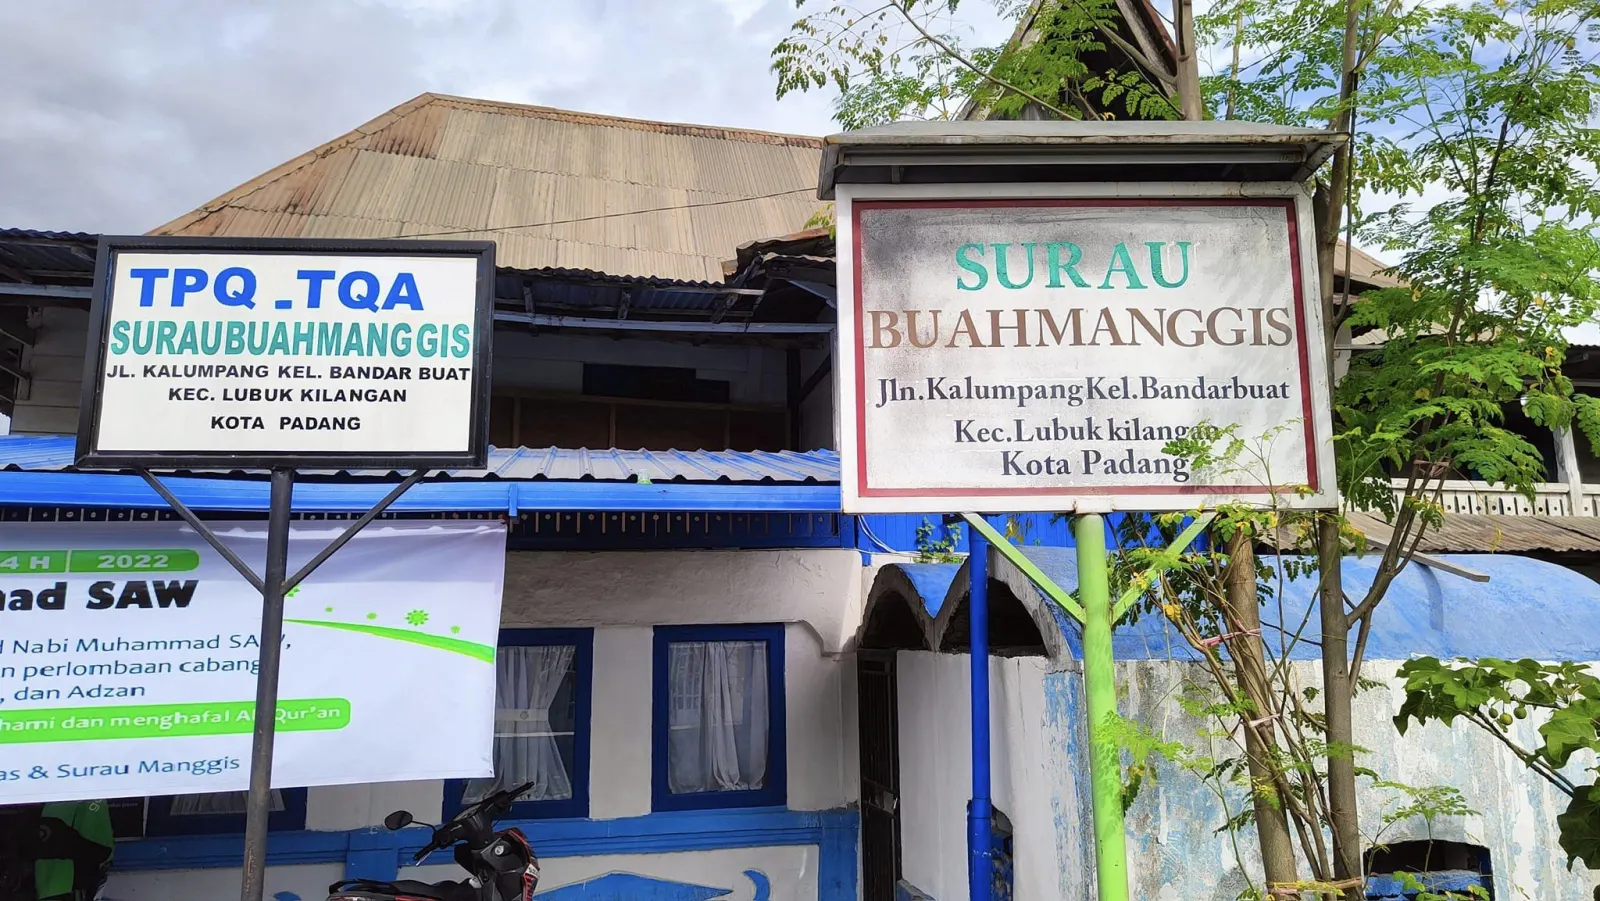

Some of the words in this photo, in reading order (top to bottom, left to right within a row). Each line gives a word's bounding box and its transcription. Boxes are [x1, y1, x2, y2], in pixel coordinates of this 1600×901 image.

[956, 240, 1192, 291] SURAU
[130, 267, 257, 310] TPQ
[296, 269, 424, 313] TQA
[110, 319, 470, 358] SURAUBUAHMANGGIS
[866, 306, 1293, 349] BUAHMANGGIS
[106, 364, 135, 378] JL.
[143, 364, 269, 379] KALUMPANG
[277, 365, 322, 380] KEL.
[329, 366, 411, 380] BANDAR
[418, 367, 471, 381] BUAT
[168, 388, 215, 402] KEC.
[222, 388, 293, 402] LUBUK
[300, 389, 407, 403] KILANGAN
[210, 416, 265, 430] KOTA
[279, 417, 361, 431] PADANG
[1001, 450, 1071, 476] Kota
[1082, 449, 1190, 483] Padang
[97, 555, 169, 569] 2022
[86, 580, 199, 610] SAW
[13, 638, 69, 654] Nabi
[76, 634, 220, 652] Muhammad
[24, 660, 171, 681] perlombaan
[179, 657, 261, 675] cabang
[14, 687, 60, 701] dan
[67, 684, 145, 698] Adzan
[61, 716, 104, 729] dan
[110, 711, 229, 730] menghafal
[28, 765, 49, 780] &
[57, 763, 129, 779] Surau
[138, 757, 240, 775] Manggis
